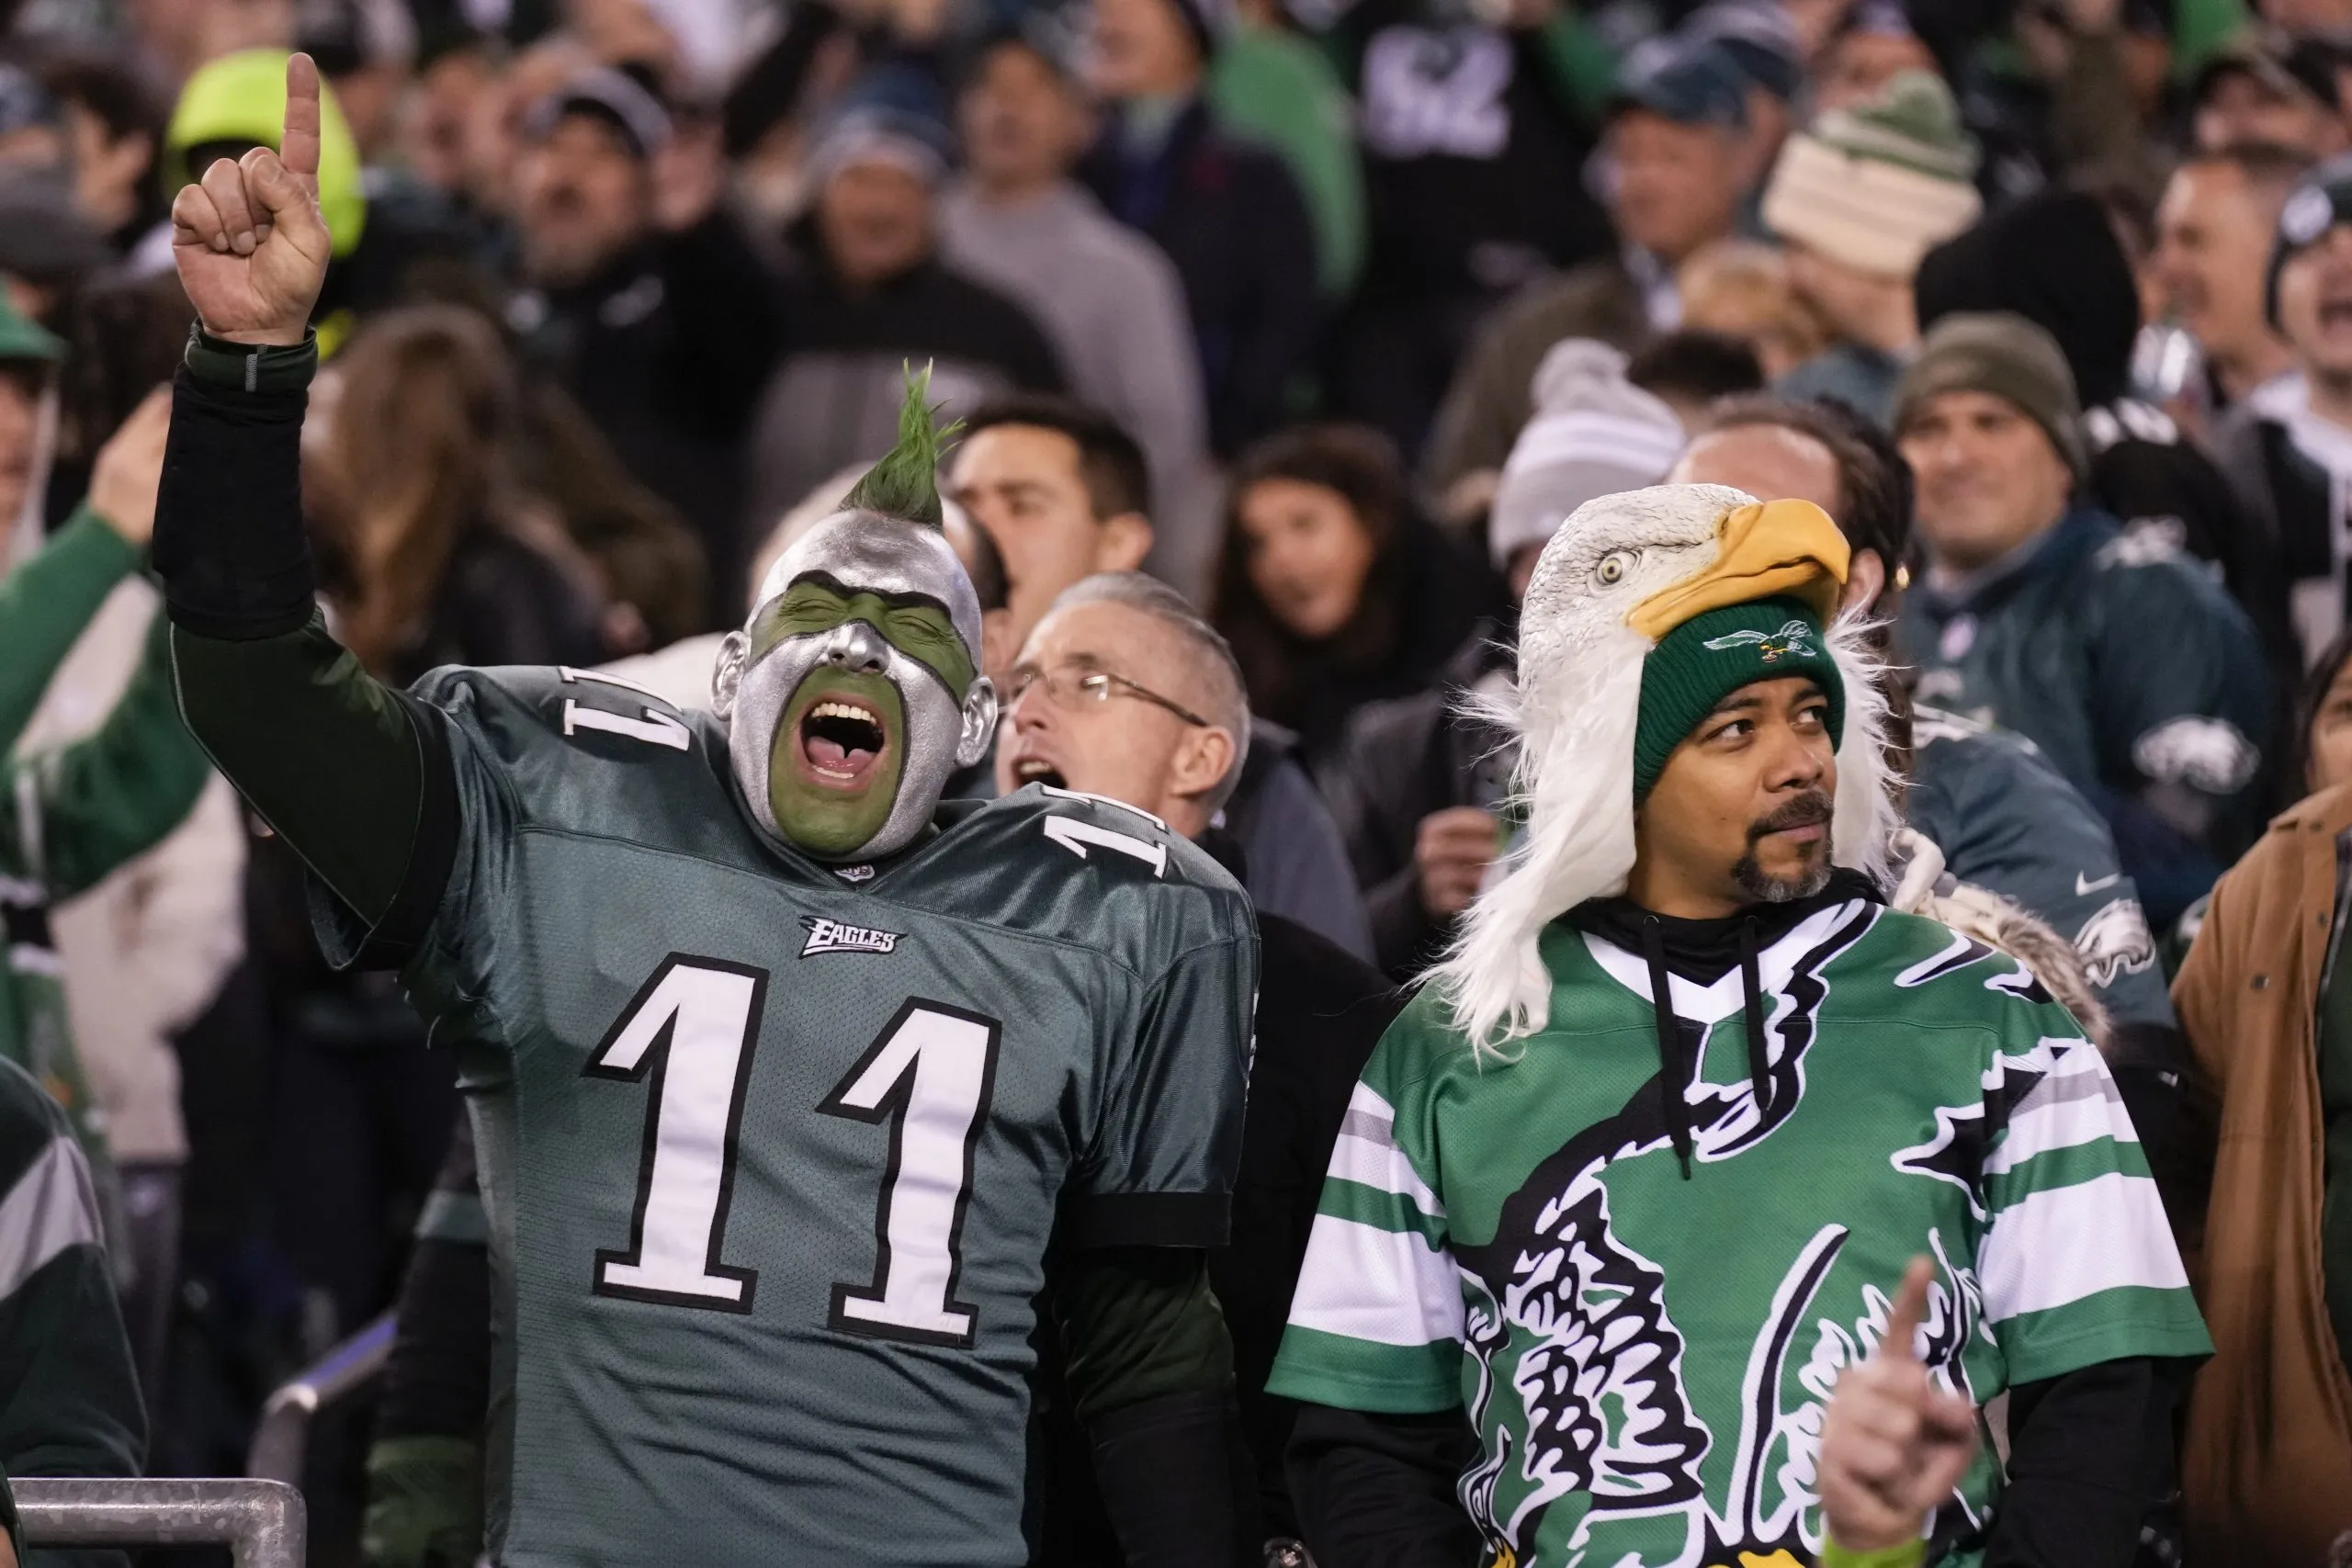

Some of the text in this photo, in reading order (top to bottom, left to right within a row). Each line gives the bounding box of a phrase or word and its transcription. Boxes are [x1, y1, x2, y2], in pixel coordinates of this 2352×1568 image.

[1041, 784, 1168, 880] 11
[801, 917, 900, 955] EAGLES
[581, 952, 1002, 1350] 11
